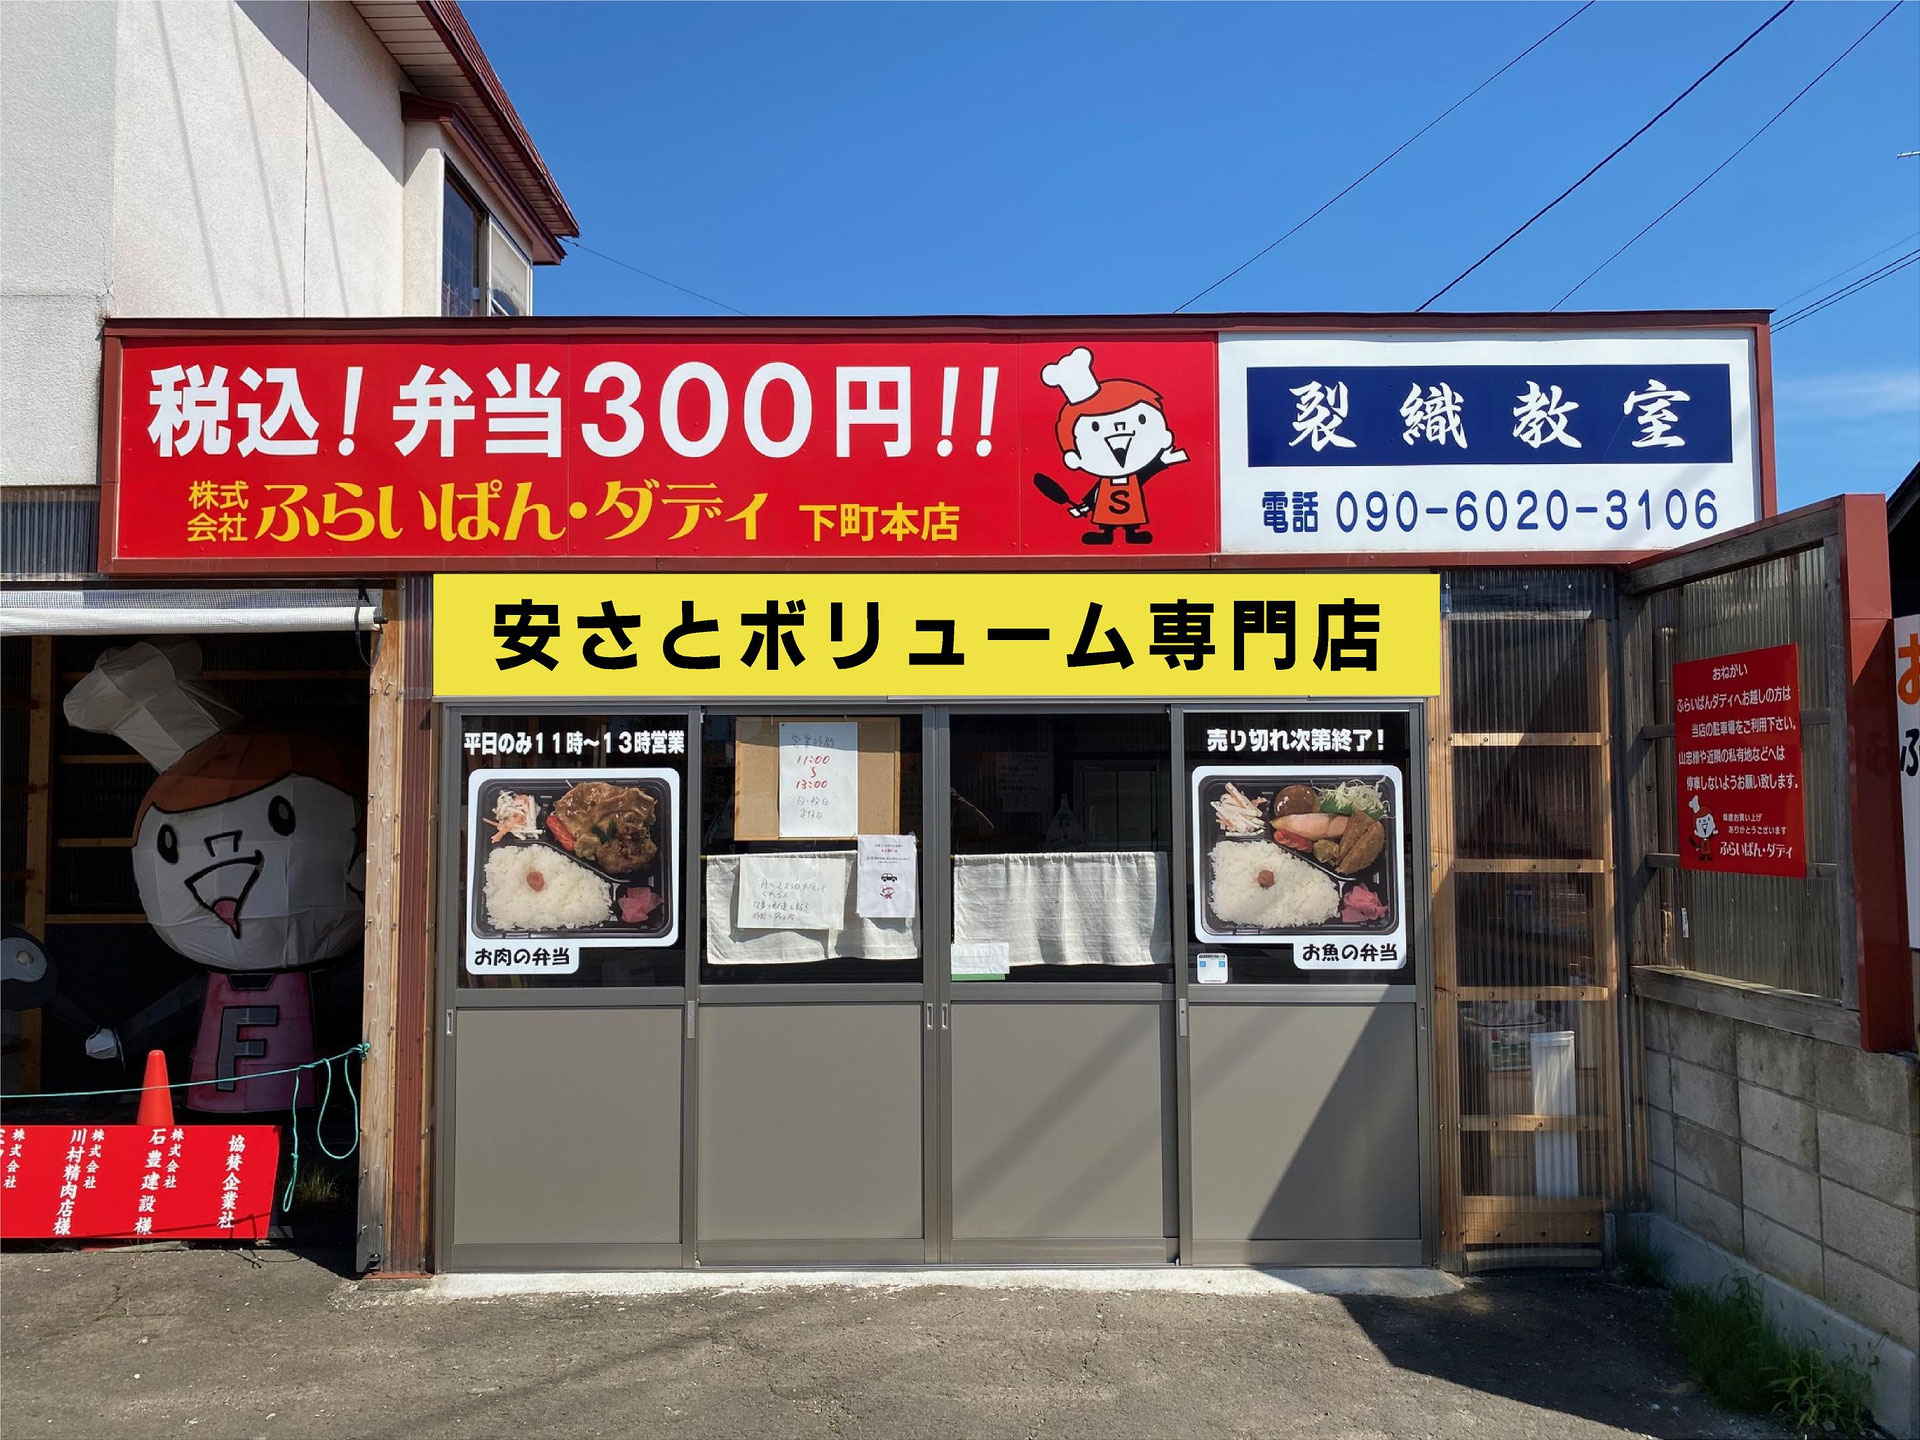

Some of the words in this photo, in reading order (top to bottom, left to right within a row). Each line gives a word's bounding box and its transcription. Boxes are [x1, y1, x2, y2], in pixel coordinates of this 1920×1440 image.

[1289, 379, 1690, 451] 裂織教室
[799, 502, 960, 542] 下町本店
[1109, 490, 1130, 515] S
[1261, 491, 1318, 533] 電話
[1335, 488, 1719, 532] 090-6020-3106
[493, 597, 1381, 672] 安さとボリューム専門店
[1712, 663, 1749, 681] おねがい
[796, 755, 831, 765] 11:00
[1207, 728, 1385, 752] 売り切れ次第終了!
[795, 780, 828, 790] 13:00
[474, 947, 571, 968] お肉の弁当
[1302, 943, 1399, 963] お魚の弁当
[216, 1006, 280, 1092] F
[3, 1128, 26, 1189] 株式会社
[83, 1128, 105, 1189] 株式会社
[163, 1128, 185, 1189] 株式会社
[53, 1128, 88, 1236] 川村精肉店様
[216, 1134, 246, 1229] 協賛企業社
